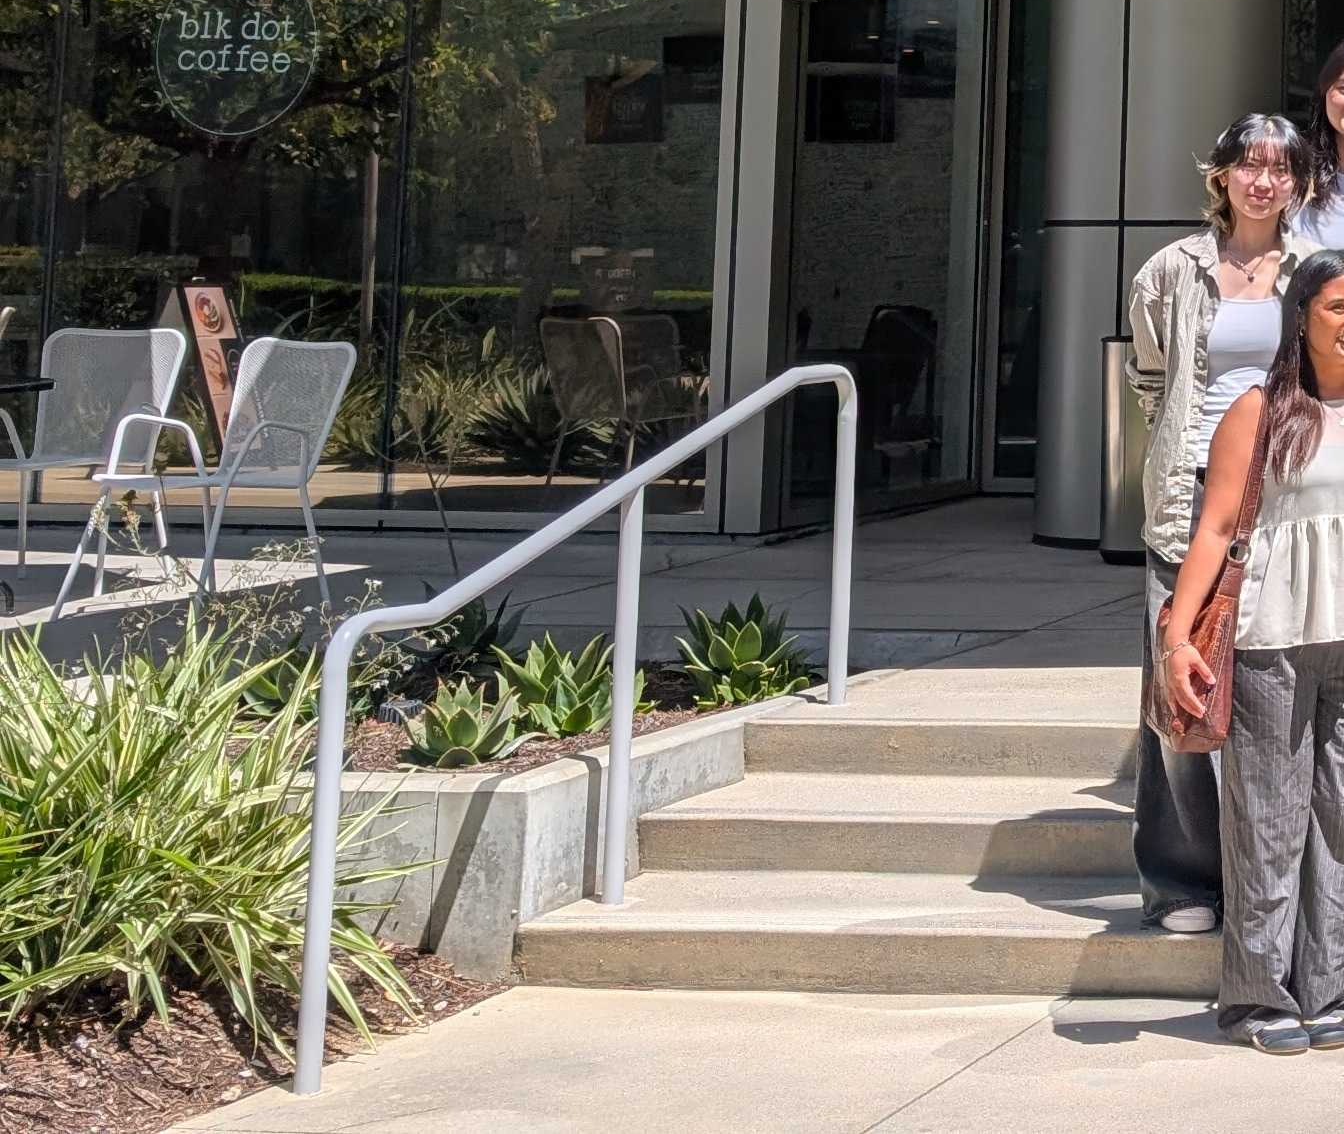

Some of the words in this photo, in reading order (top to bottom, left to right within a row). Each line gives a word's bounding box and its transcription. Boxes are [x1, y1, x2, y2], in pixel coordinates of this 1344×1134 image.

[178, 11, 232, 40] blk
[241, 11, 295, 41] dot
[177, 44, 291, 73] coffee
